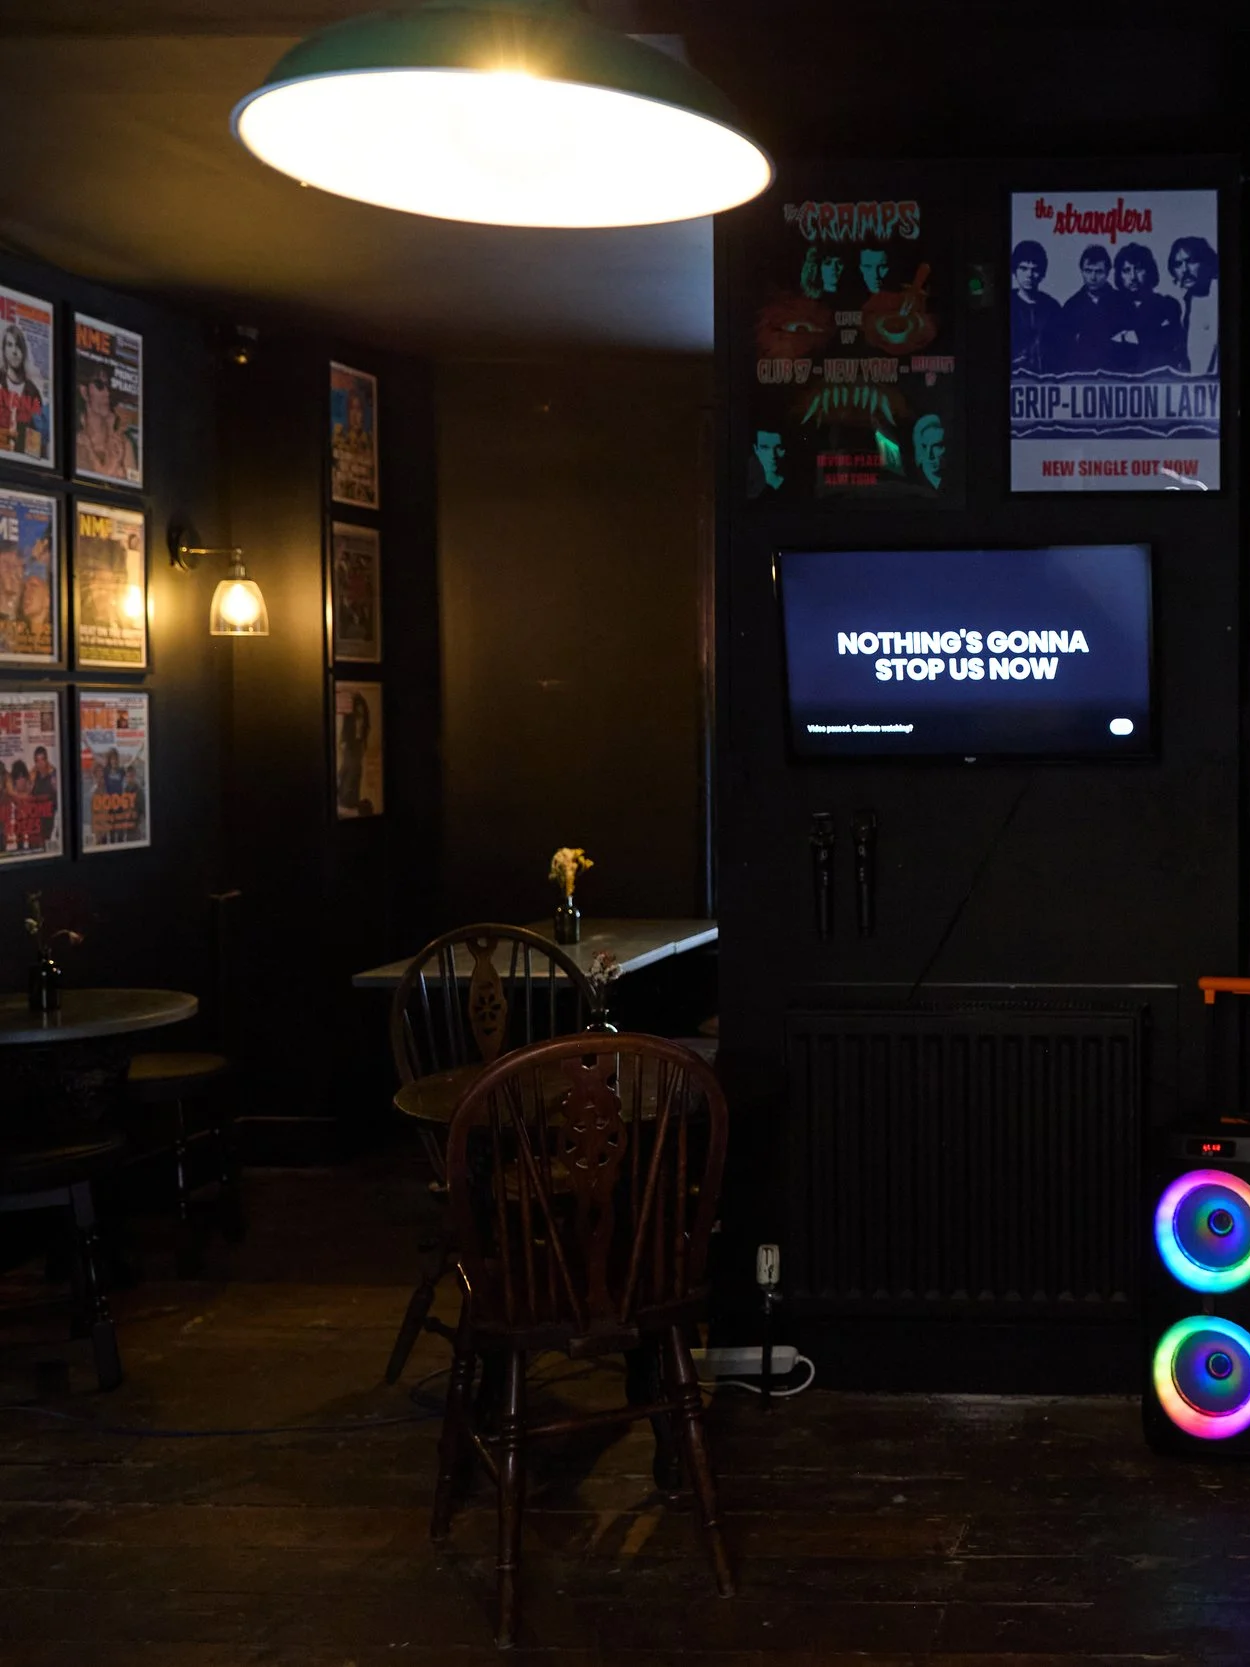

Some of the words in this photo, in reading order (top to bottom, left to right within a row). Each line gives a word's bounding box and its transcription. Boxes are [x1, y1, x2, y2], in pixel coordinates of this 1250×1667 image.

[799, 200, 921, 241] CRAMPS
[1035, 198, 1053, 219] the
[1053, 198, 1152, 244] stranglers
[1011, 384, 1158, 419] GRIP-LONDON
[1165, 384, 1218, 418] LADY
[1042, 460, 1075, 477] NEW
[1078, 460, 1128, 476] SINGLE
[1131, 460, 1161, 476] OUT
[1162, 459, 1199, 477] NOW
[80, 513, 115, 539] NME
[838, 629, 983, 655] NOTHING'S
[986, 630, 1089, 653] GONNA
[875, 658, 945, 681] STOP
[949, 658, 985, 681] US
[989, 657, 1058, 680] NOW
